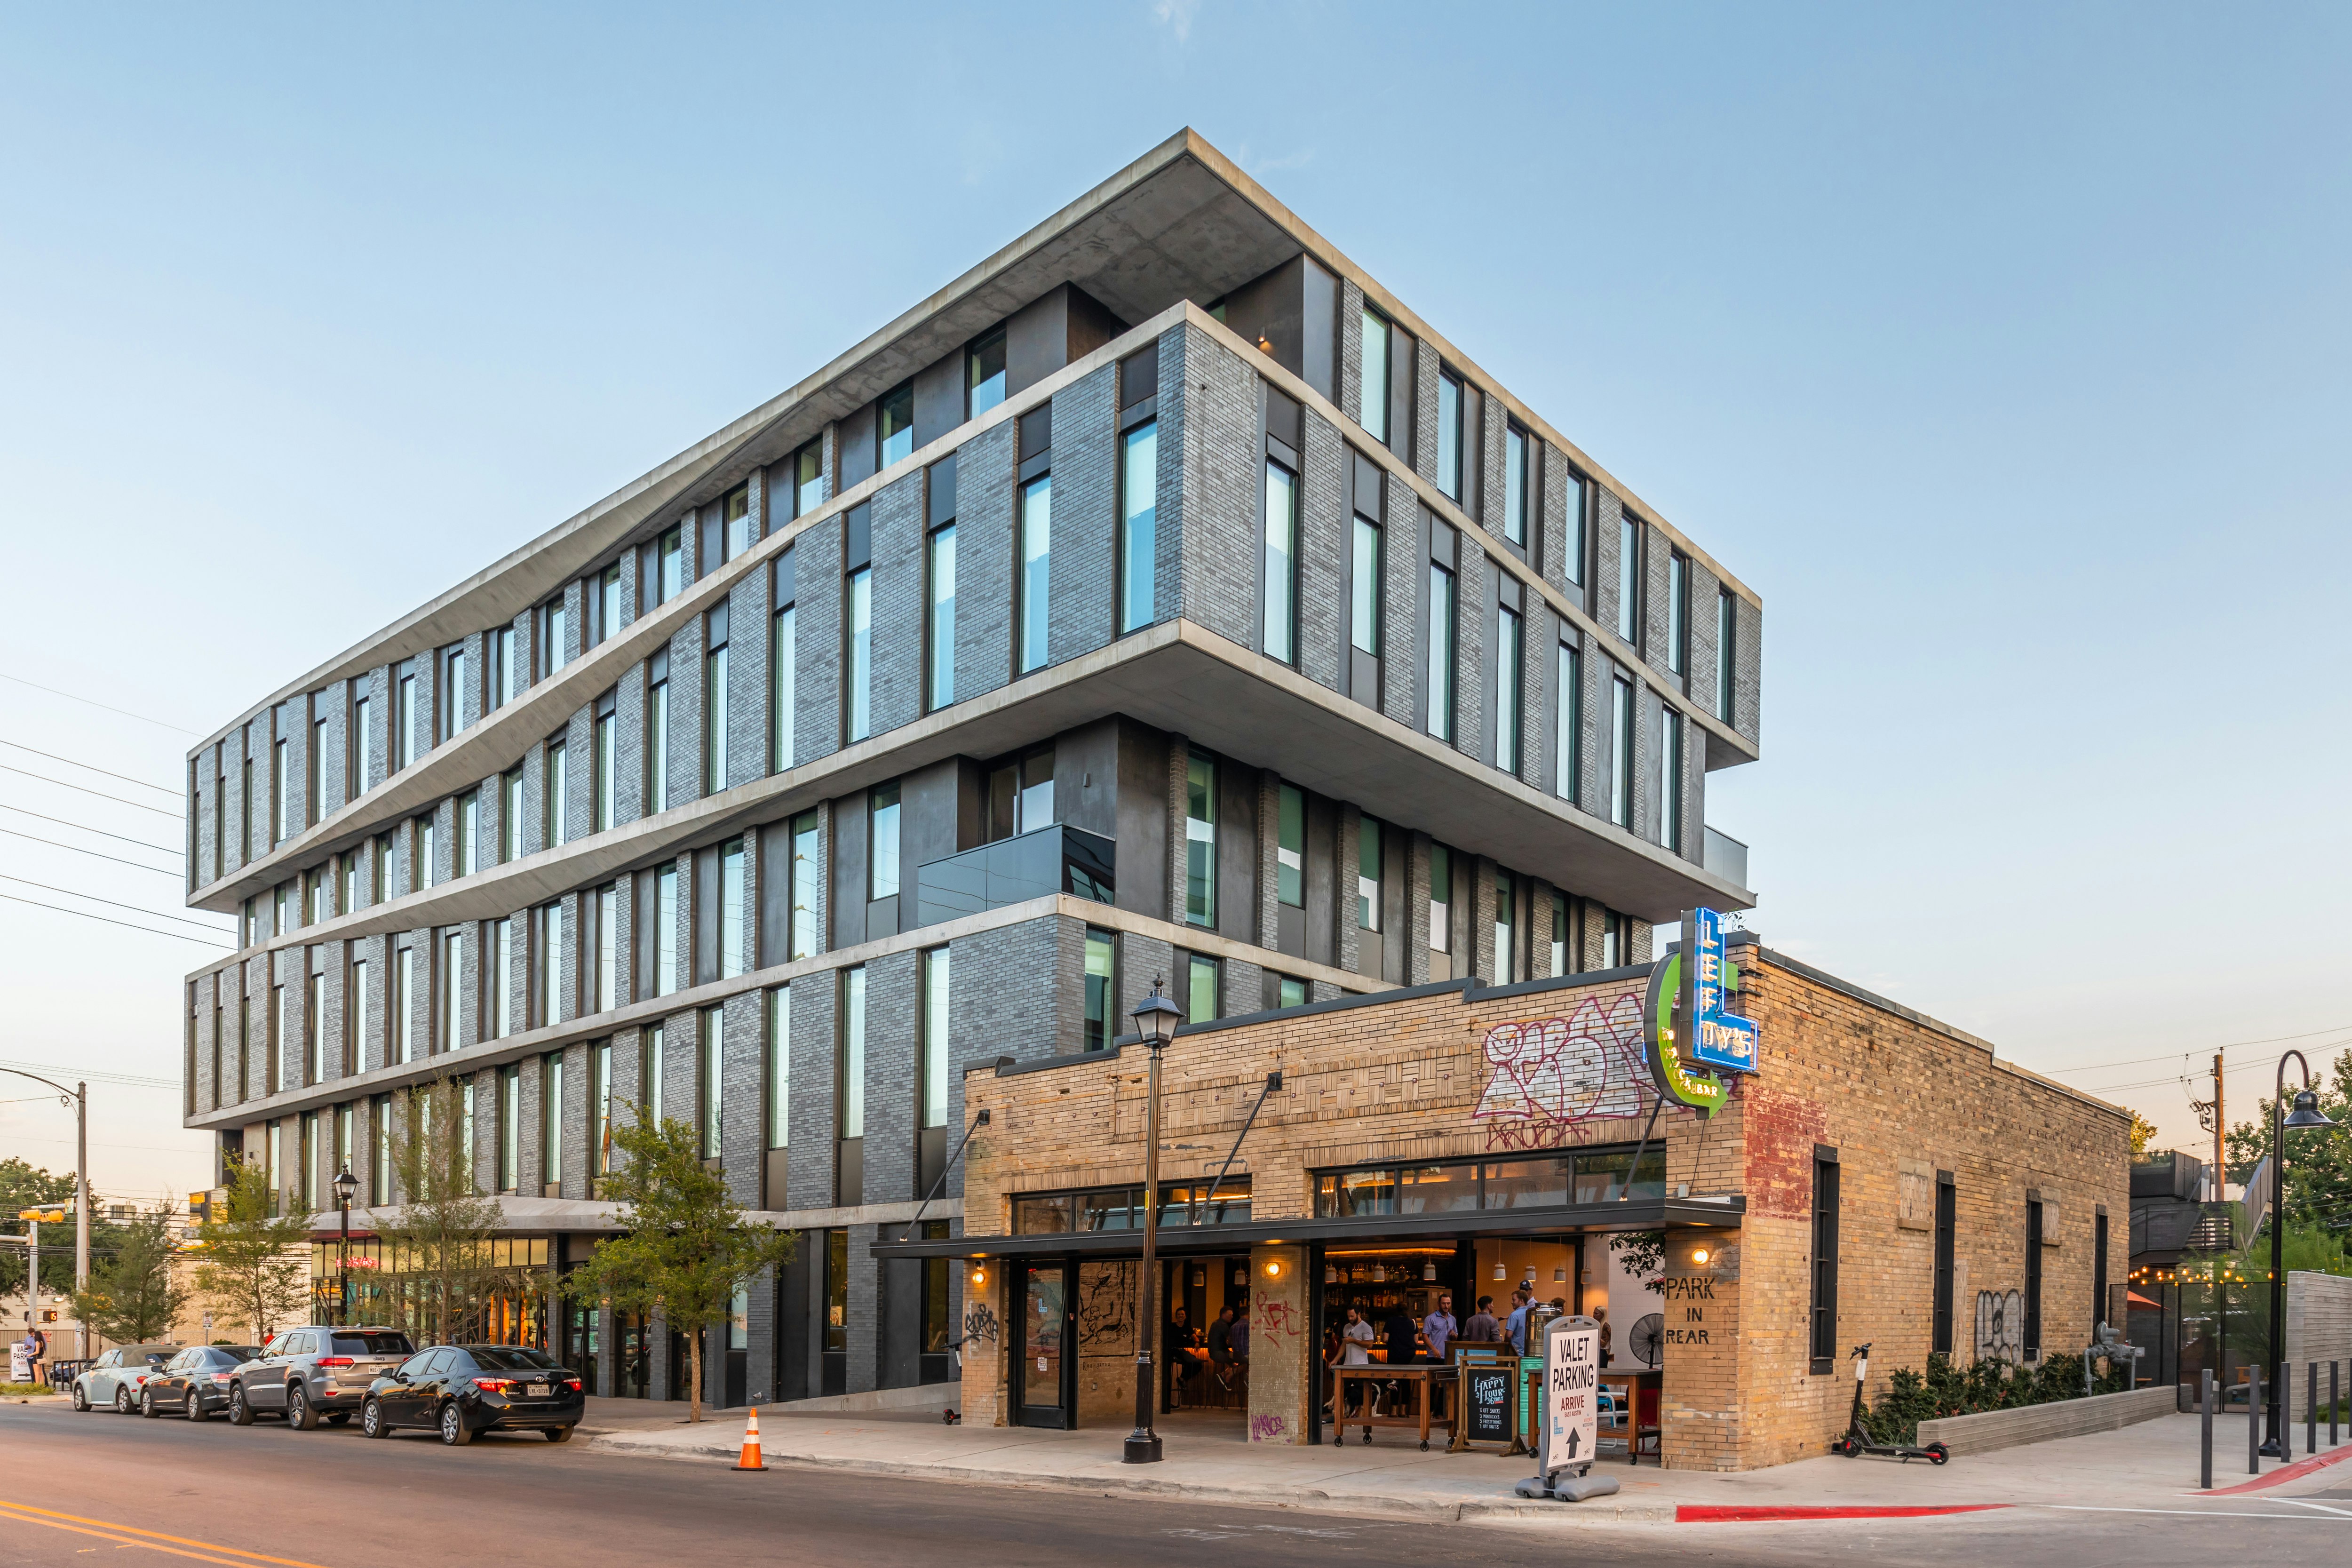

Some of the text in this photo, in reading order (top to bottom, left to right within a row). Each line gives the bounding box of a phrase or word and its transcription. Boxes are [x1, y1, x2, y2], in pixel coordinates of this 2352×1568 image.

[1696, 1083, 1718, 1098] BAR
[1666, 1277, 1715, 1299] PARK
[1687, 1307, 1702, 1322] IN
[1666, 1329, 1709, 1344] REAR
[1560, 1337, 1589, 1363] VALET
[1474, 1377, 1504, 1392] HAPPY
[1553, 1364, 1593, 1392] PARKING
[1479, 1388, 1504, 1404] HOUR
[1561, 1395, 1584, 1411] ARRIVE
